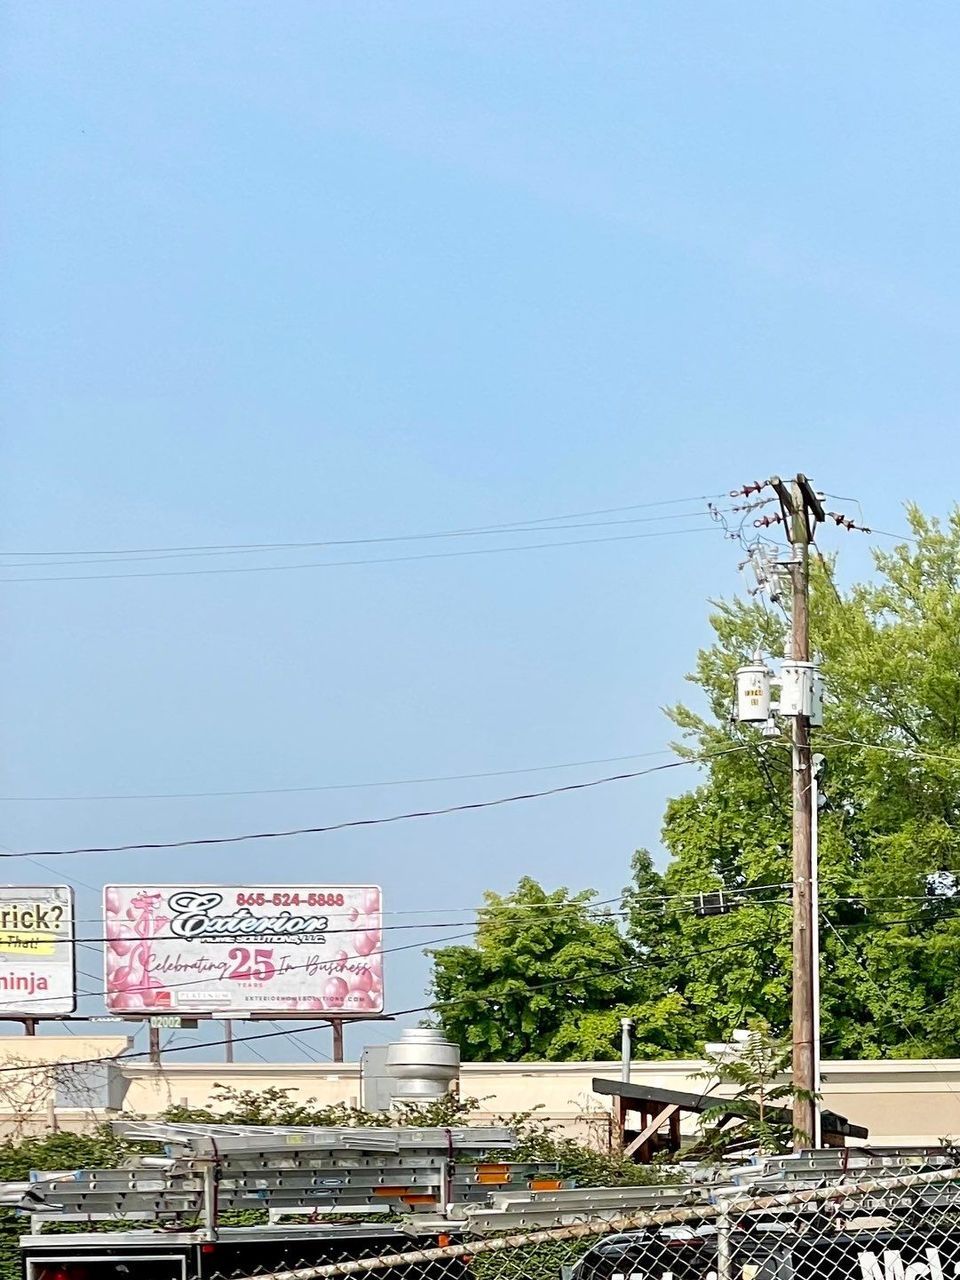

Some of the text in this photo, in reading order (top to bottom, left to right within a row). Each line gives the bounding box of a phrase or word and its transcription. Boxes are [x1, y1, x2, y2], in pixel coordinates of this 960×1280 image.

[236, 893, 344, 906] 865-524-5888
[2, 904, 63, 929] rick?
[168, 892, 328, 941] Exterior
[143, 954, 231, 981] Celebrating
[228, 948, 275, 981] 25
[276, 955, 371, 976] In Business
[151, 1017, 181, 1028] 02002
